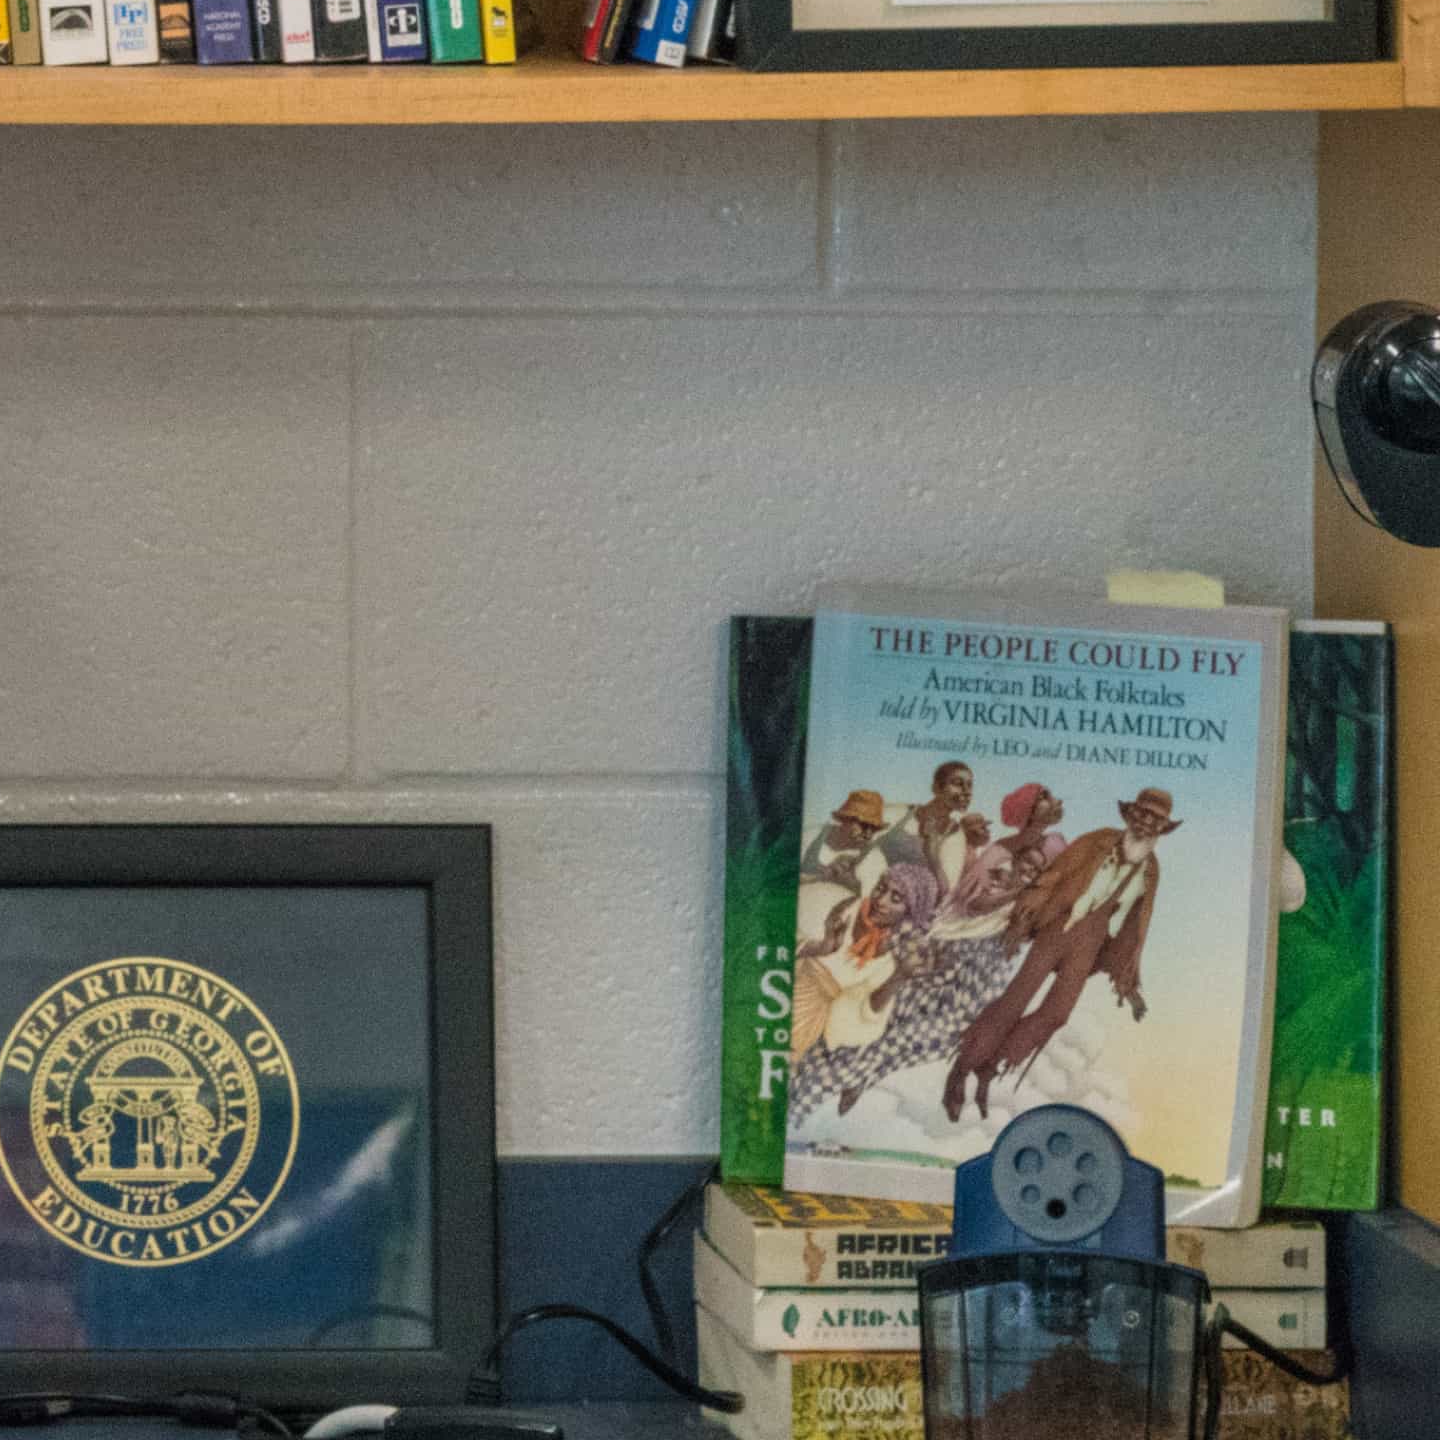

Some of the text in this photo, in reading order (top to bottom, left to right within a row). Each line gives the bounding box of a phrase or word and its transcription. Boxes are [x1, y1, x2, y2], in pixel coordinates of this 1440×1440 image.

[870, 627, 1244, 676] THE PEOPLE COULD FLY
[923, 668, 1185, 708] American Black Folktales
[880, 696, 1228, 743] told by VIRGINIA HAMILTON
[896, 732, 1208, 771] Illustrated by LEO and DIANE DILLON
[7, 966, 284, 1078] DEPARTMENT OF
[44, 1011, 246, 1137] STATE OF GEORGIA
[32, 1185, 261, 1260] EDUCATION
[120, 1194, 179, 1214] 1776
